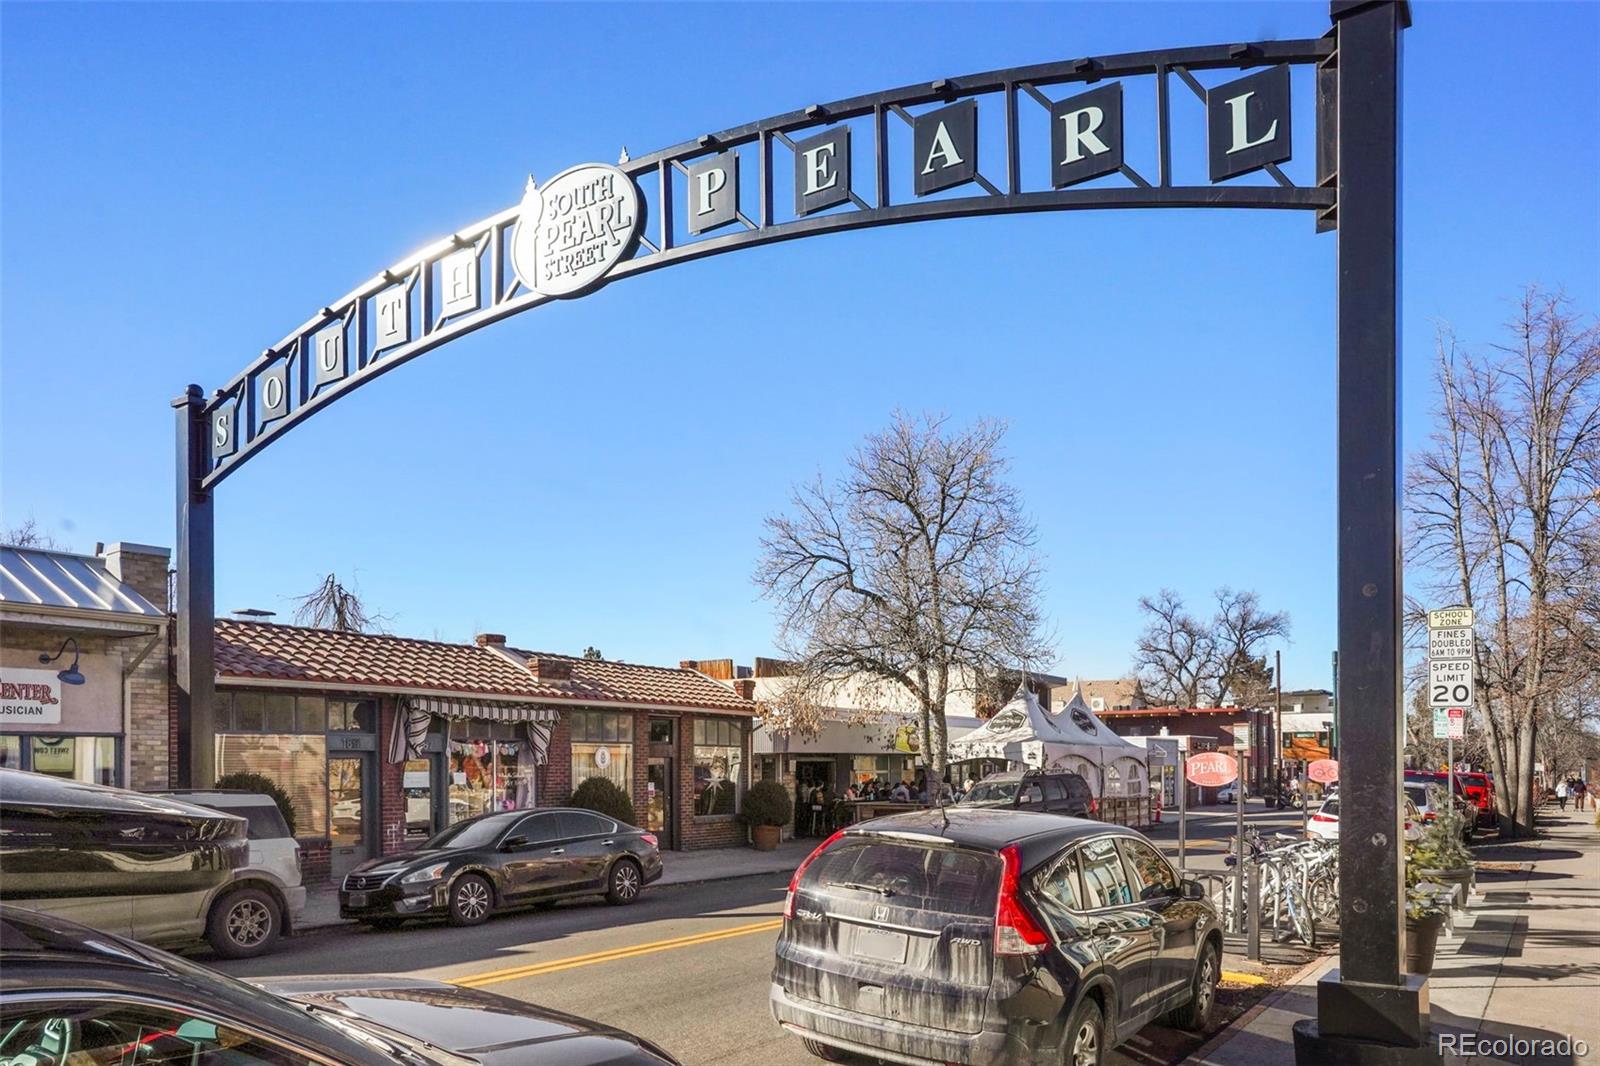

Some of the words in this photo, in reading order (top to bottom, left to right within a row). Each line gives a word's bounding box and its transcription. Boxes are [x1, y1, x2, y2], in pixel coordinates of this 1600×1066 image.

[549, 174, 615, 221] SOUTH
[544, 196, 632, 258] PEARL
[545, 240, 608, 281] STREET
[215, 261, 473, 448] SOUTH
[696, 91, 1278, 216] PEARL
[1433, 611, 1469, 619] SCHOOL
[1439, 618, 1463, 626] ZONE
[1437, 630, 1466, 638] FINES
[1431, 639, 1471, 648] DOUBLED
[1447, 648, 1455, 656] TO
[1432, 662, 1470, 671] SPEED
[1436, 674, 1465, 682] LIMIT
[0, 682, 59, 705] ENTER
[1433, 684, 1469, 702] 20
[1191, 760, 1231, 776] PEARL
[950, 937, 981, 946] AWD
